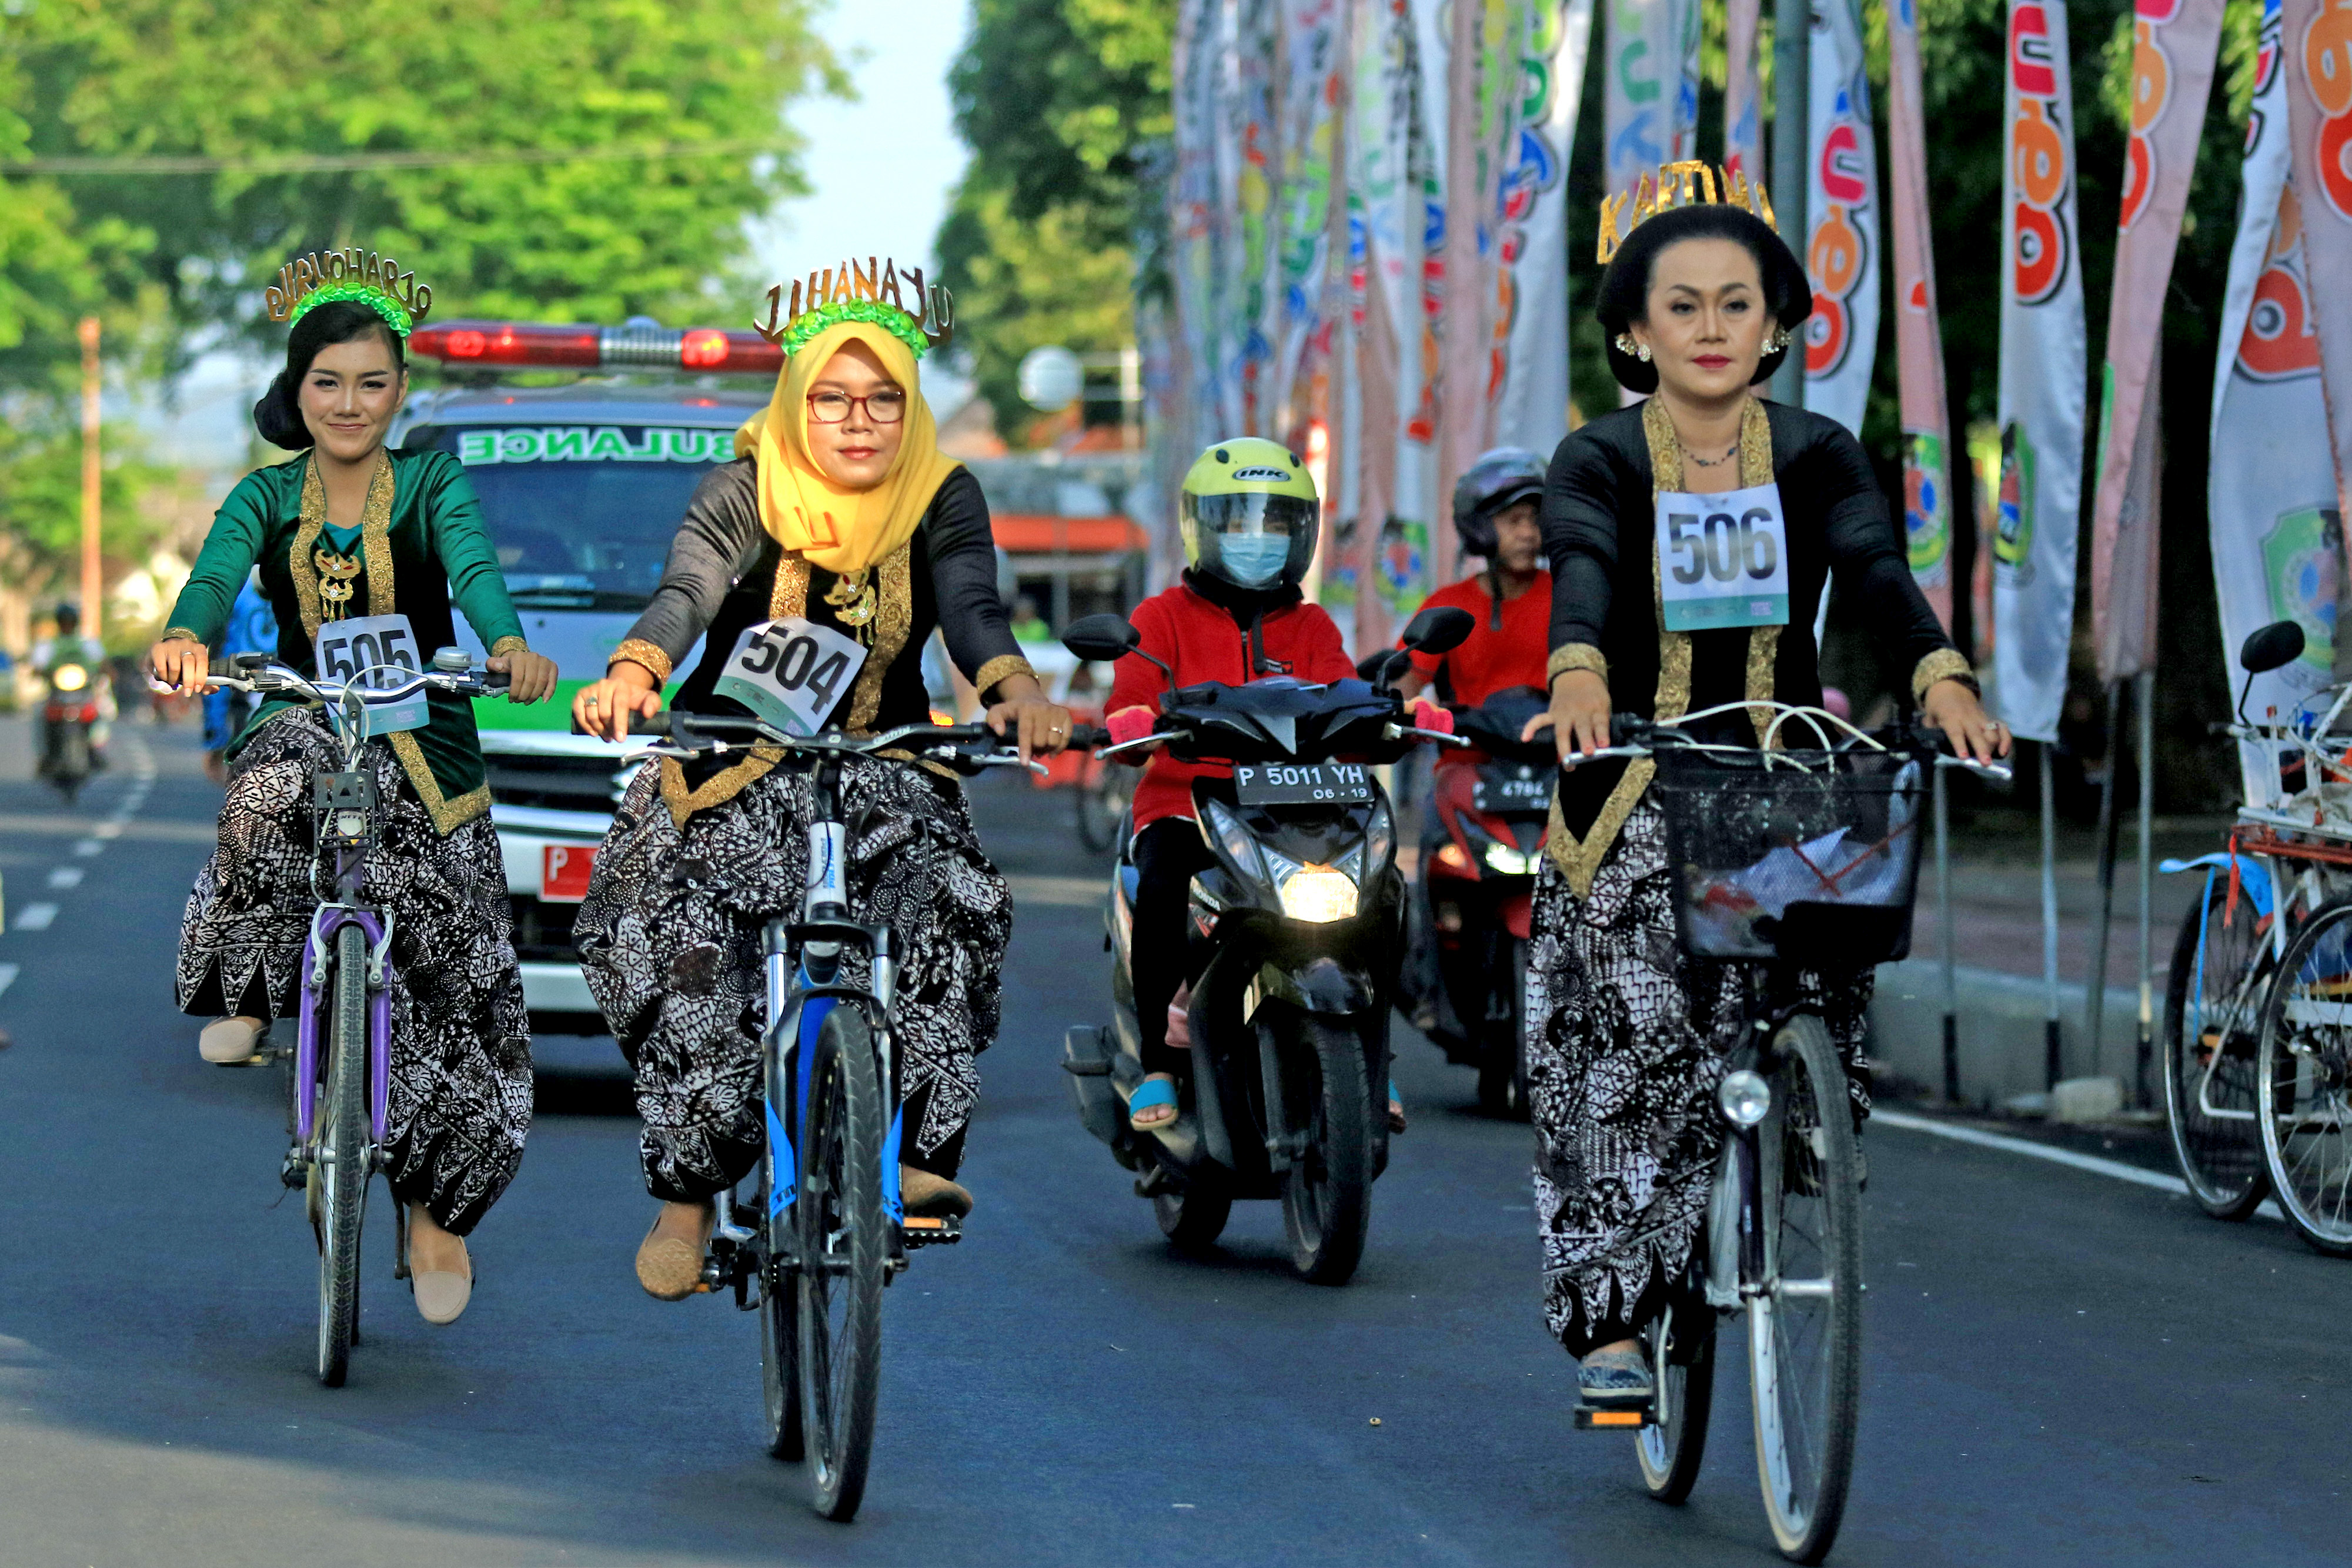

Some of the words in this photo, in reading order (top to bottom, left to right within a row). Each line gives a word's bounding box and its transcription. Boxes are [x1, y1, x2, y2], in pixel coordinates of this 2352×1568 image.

[1240, 469, 1282, 478] INK
[1669, 507, 1777, 584] 506
[323, 630, 415, 690] 505
[741, 625, 851, 716] 504
[1238, 767, 1255, 787] P
[1266, 767, 1322, 785] 5011
[1331, 765, 1365, 784] YH
[549, 847, 569, 881] P
